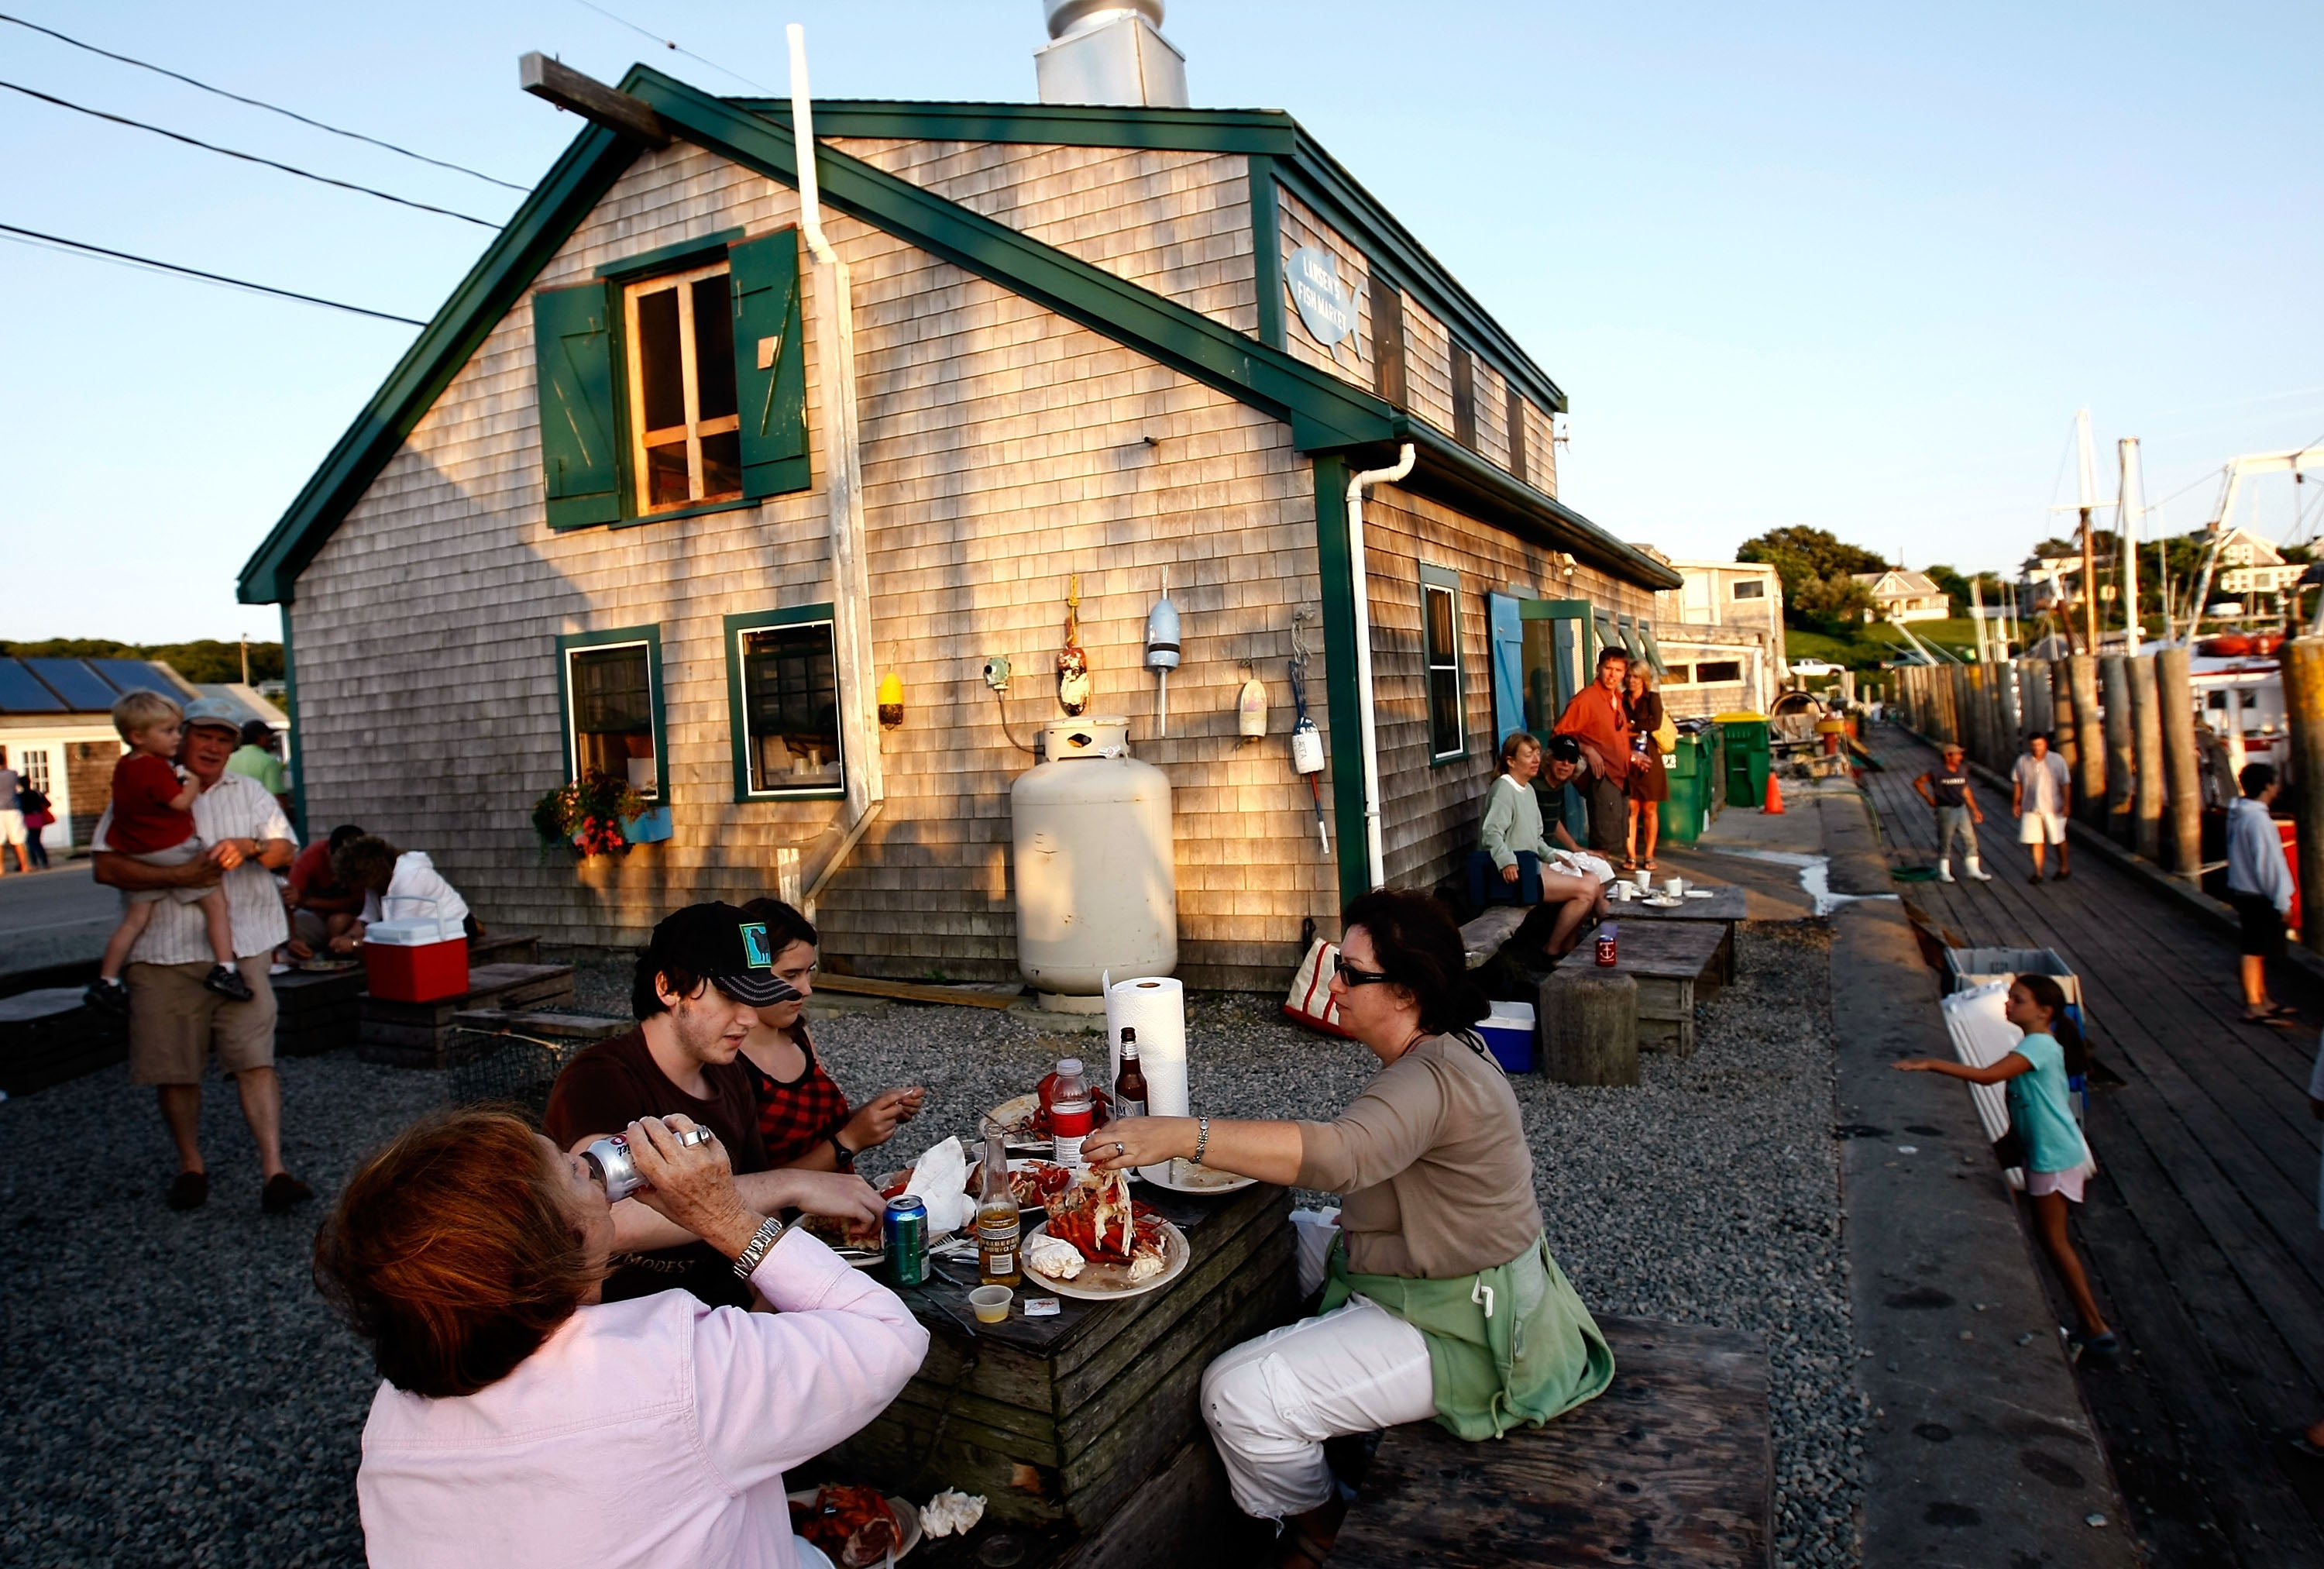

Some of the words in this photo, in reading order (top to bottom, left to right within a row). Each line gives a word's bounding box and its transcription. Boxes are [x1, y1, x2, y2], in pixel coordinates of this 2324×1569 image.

[1302, 255, 1341, 301] LARSEN'S
[1297, 280, 1317, 311] FISH
[1318, 294, 1347, 334] MARKET
[624, 1252, 695, 1273] MODEST
